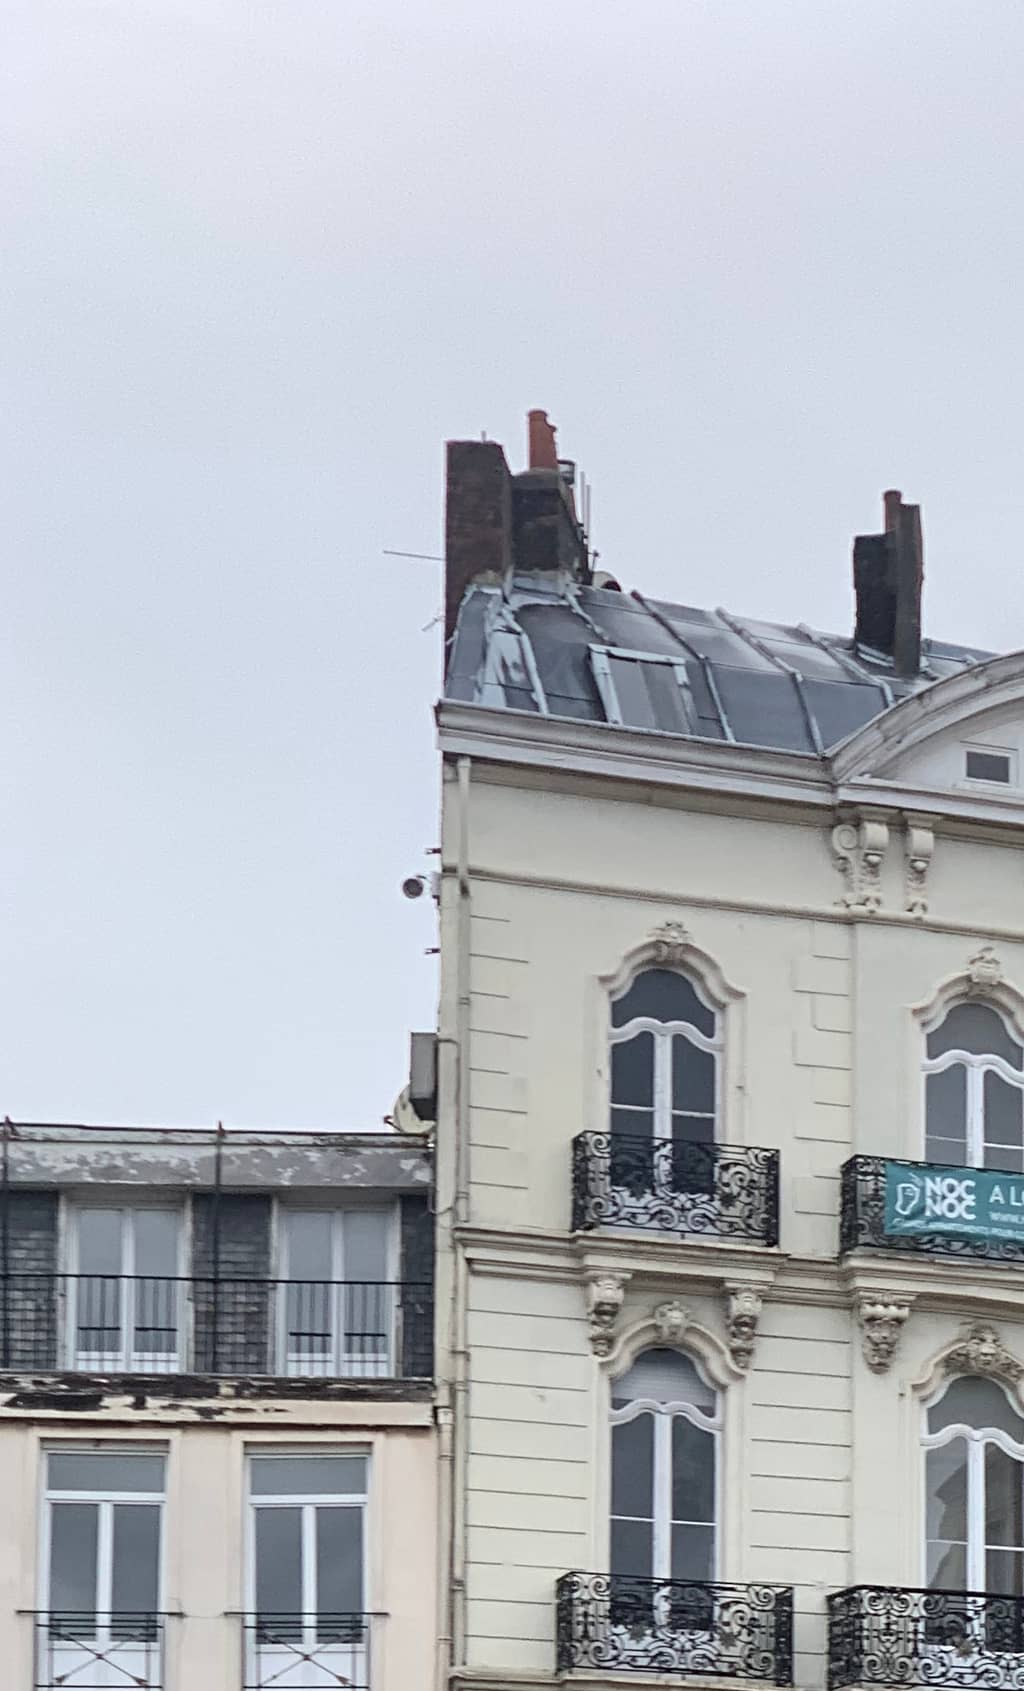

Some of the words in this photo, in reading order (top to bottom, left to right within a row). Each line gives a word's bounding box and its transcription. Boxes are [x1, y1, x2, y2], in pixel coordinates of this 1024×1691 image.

[924, 1176, 976, 1201] NOC
[989, 1185, 1005, 1205] A
[924, 1196, 976, 1221] NOC
